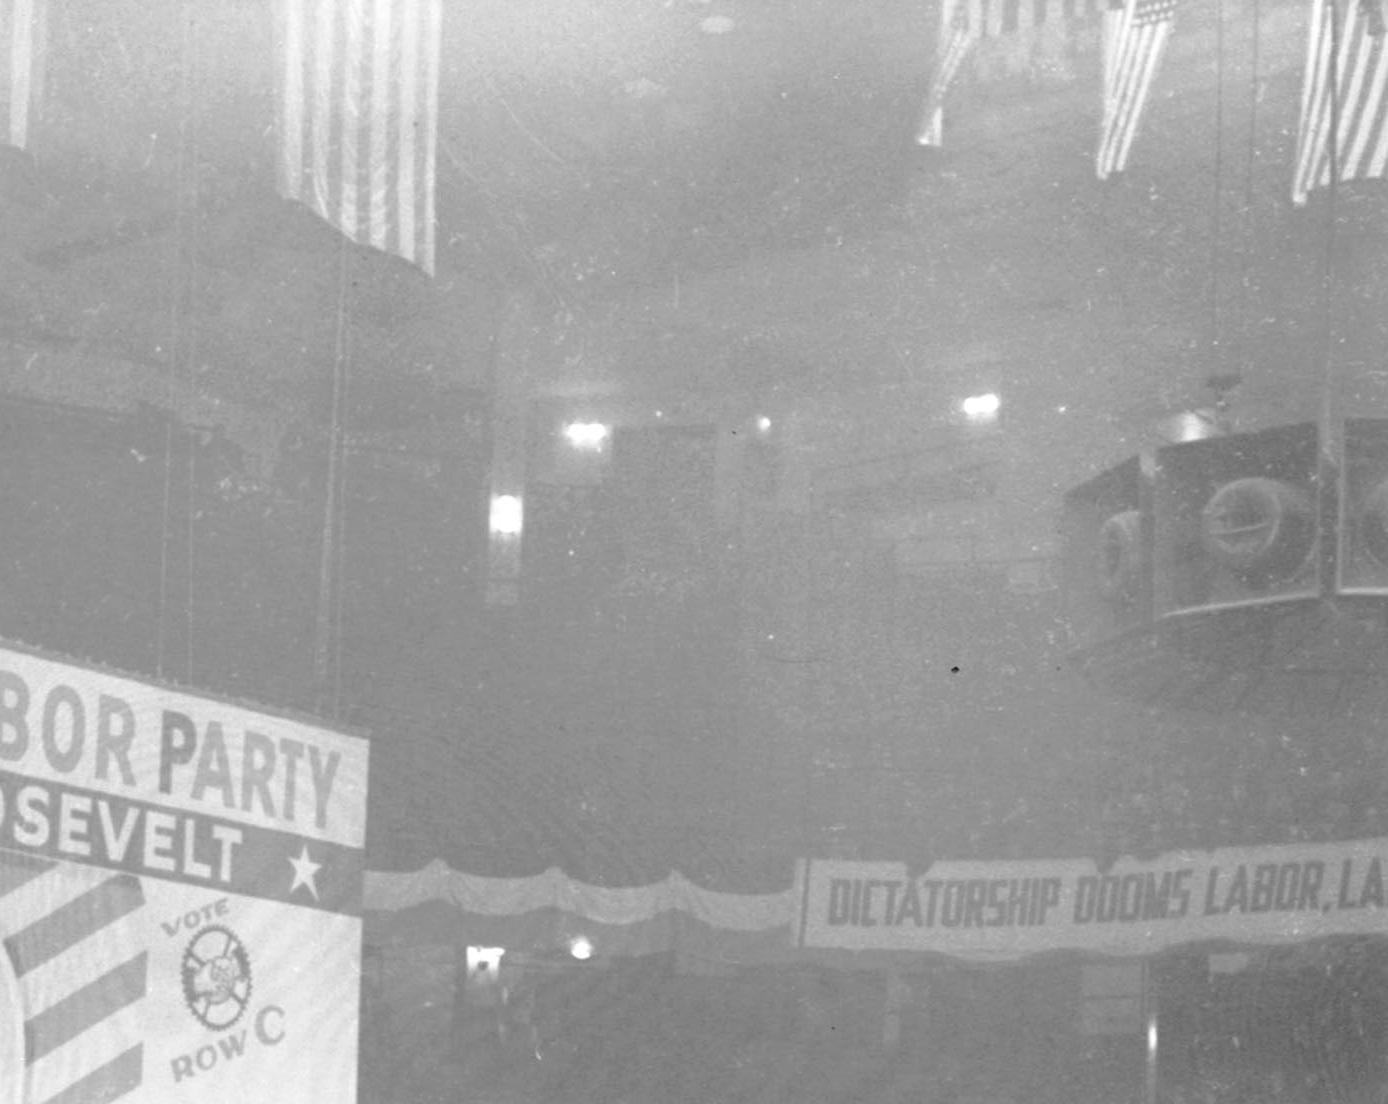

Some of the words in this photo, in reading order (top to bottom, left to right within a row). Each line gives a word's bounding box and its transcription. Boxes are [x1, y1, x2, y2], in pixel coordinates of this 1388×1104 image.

[158, 708, 342, 830] PARTY
[160, 897, 231, 937] VOTE
[827, 876, 1062, 928] DICTATORSHIP
[1073, 868, 1195, 924] DOOMS
[170, 1028, 248, 1083] ROW
[254, 1004, 286, 1046] C
